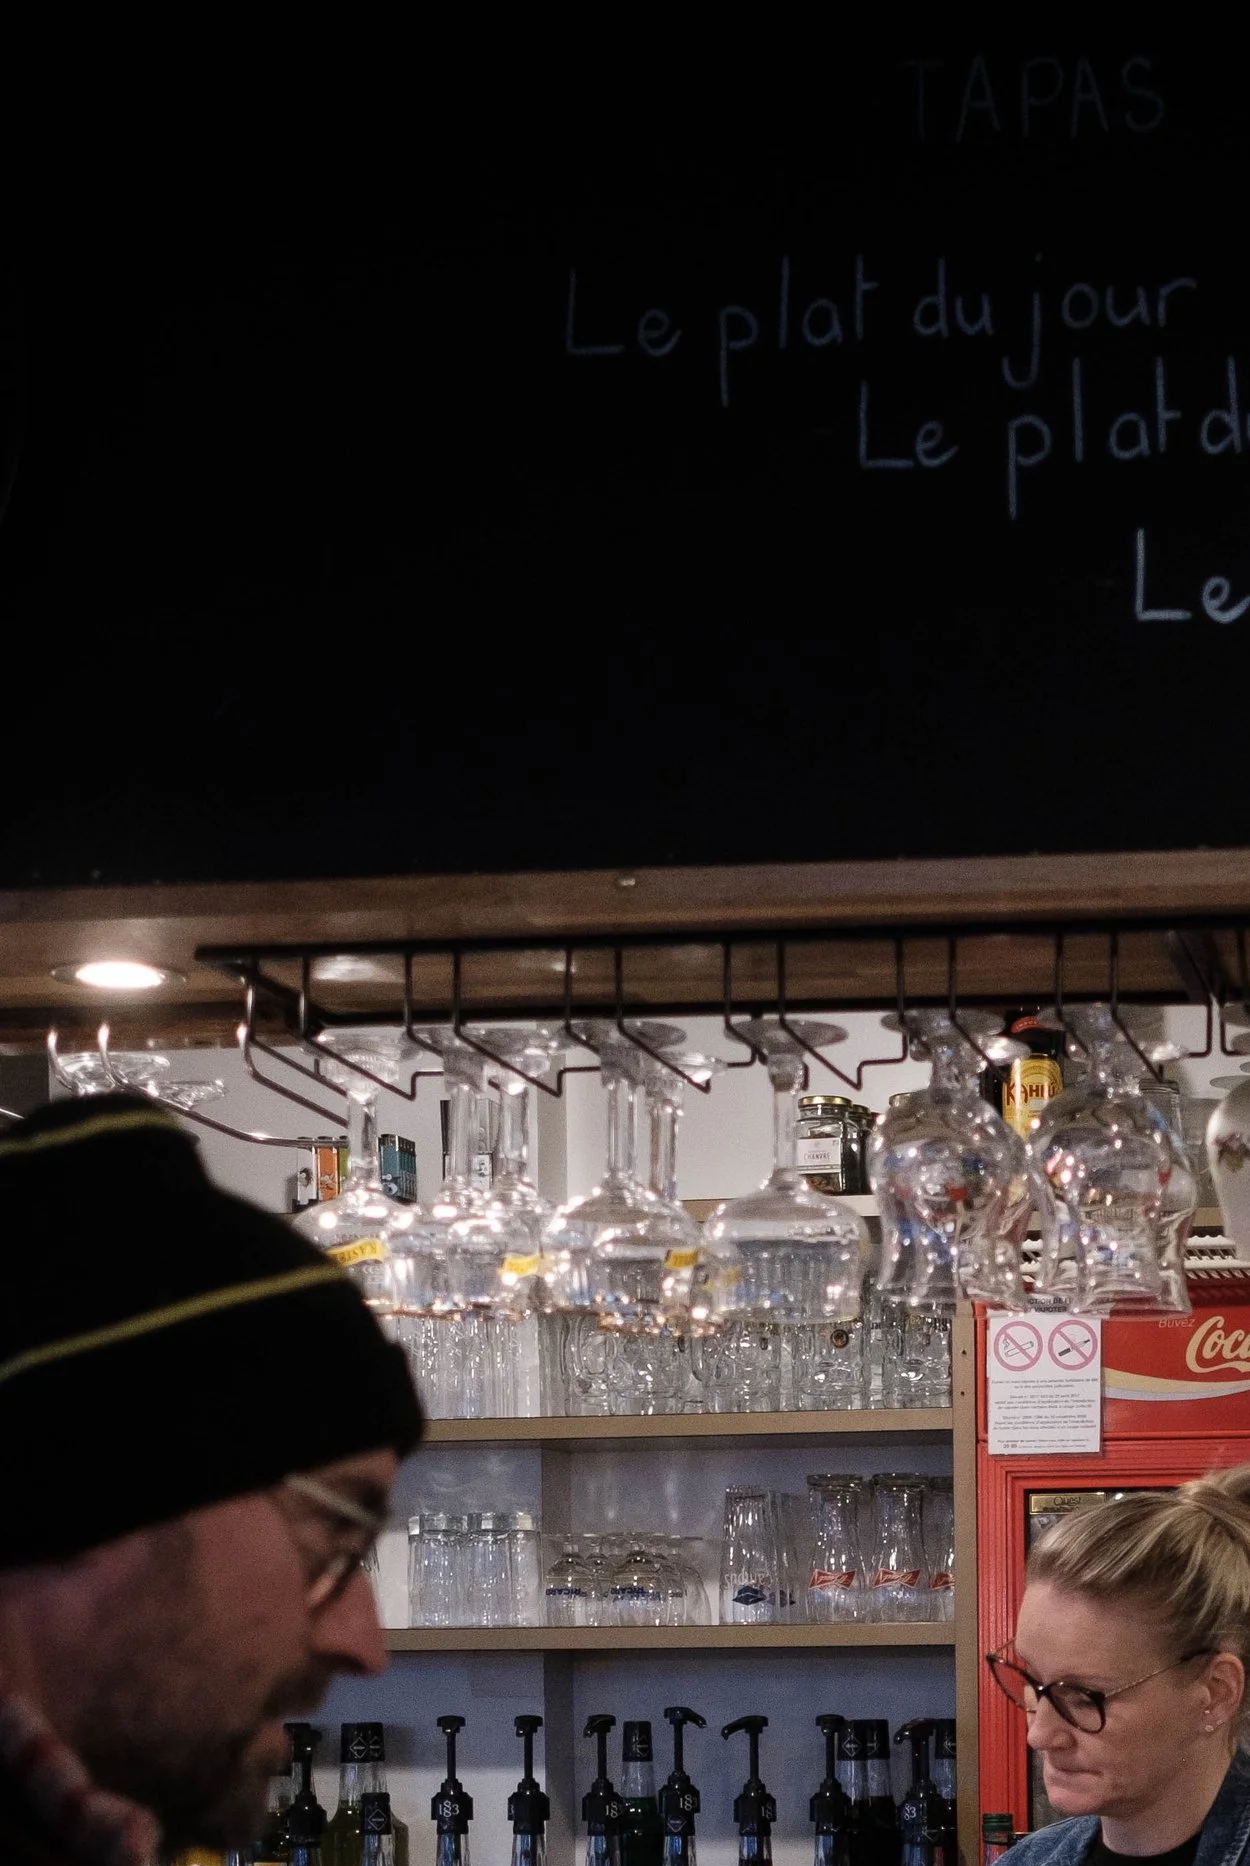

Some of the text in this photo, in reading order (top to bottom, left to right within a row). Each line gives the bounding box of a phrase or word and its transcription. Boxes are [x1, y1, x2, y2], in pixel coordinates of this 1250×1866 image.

[900, 54, 1168, 144] TAPAS
[566, 250, 1198, 408] Le plat du jour
[858, 378, 960, 470] Le
[1006, 354, 1182, 522] plat
[1158, 1318, 1197, 1329] Buvez
